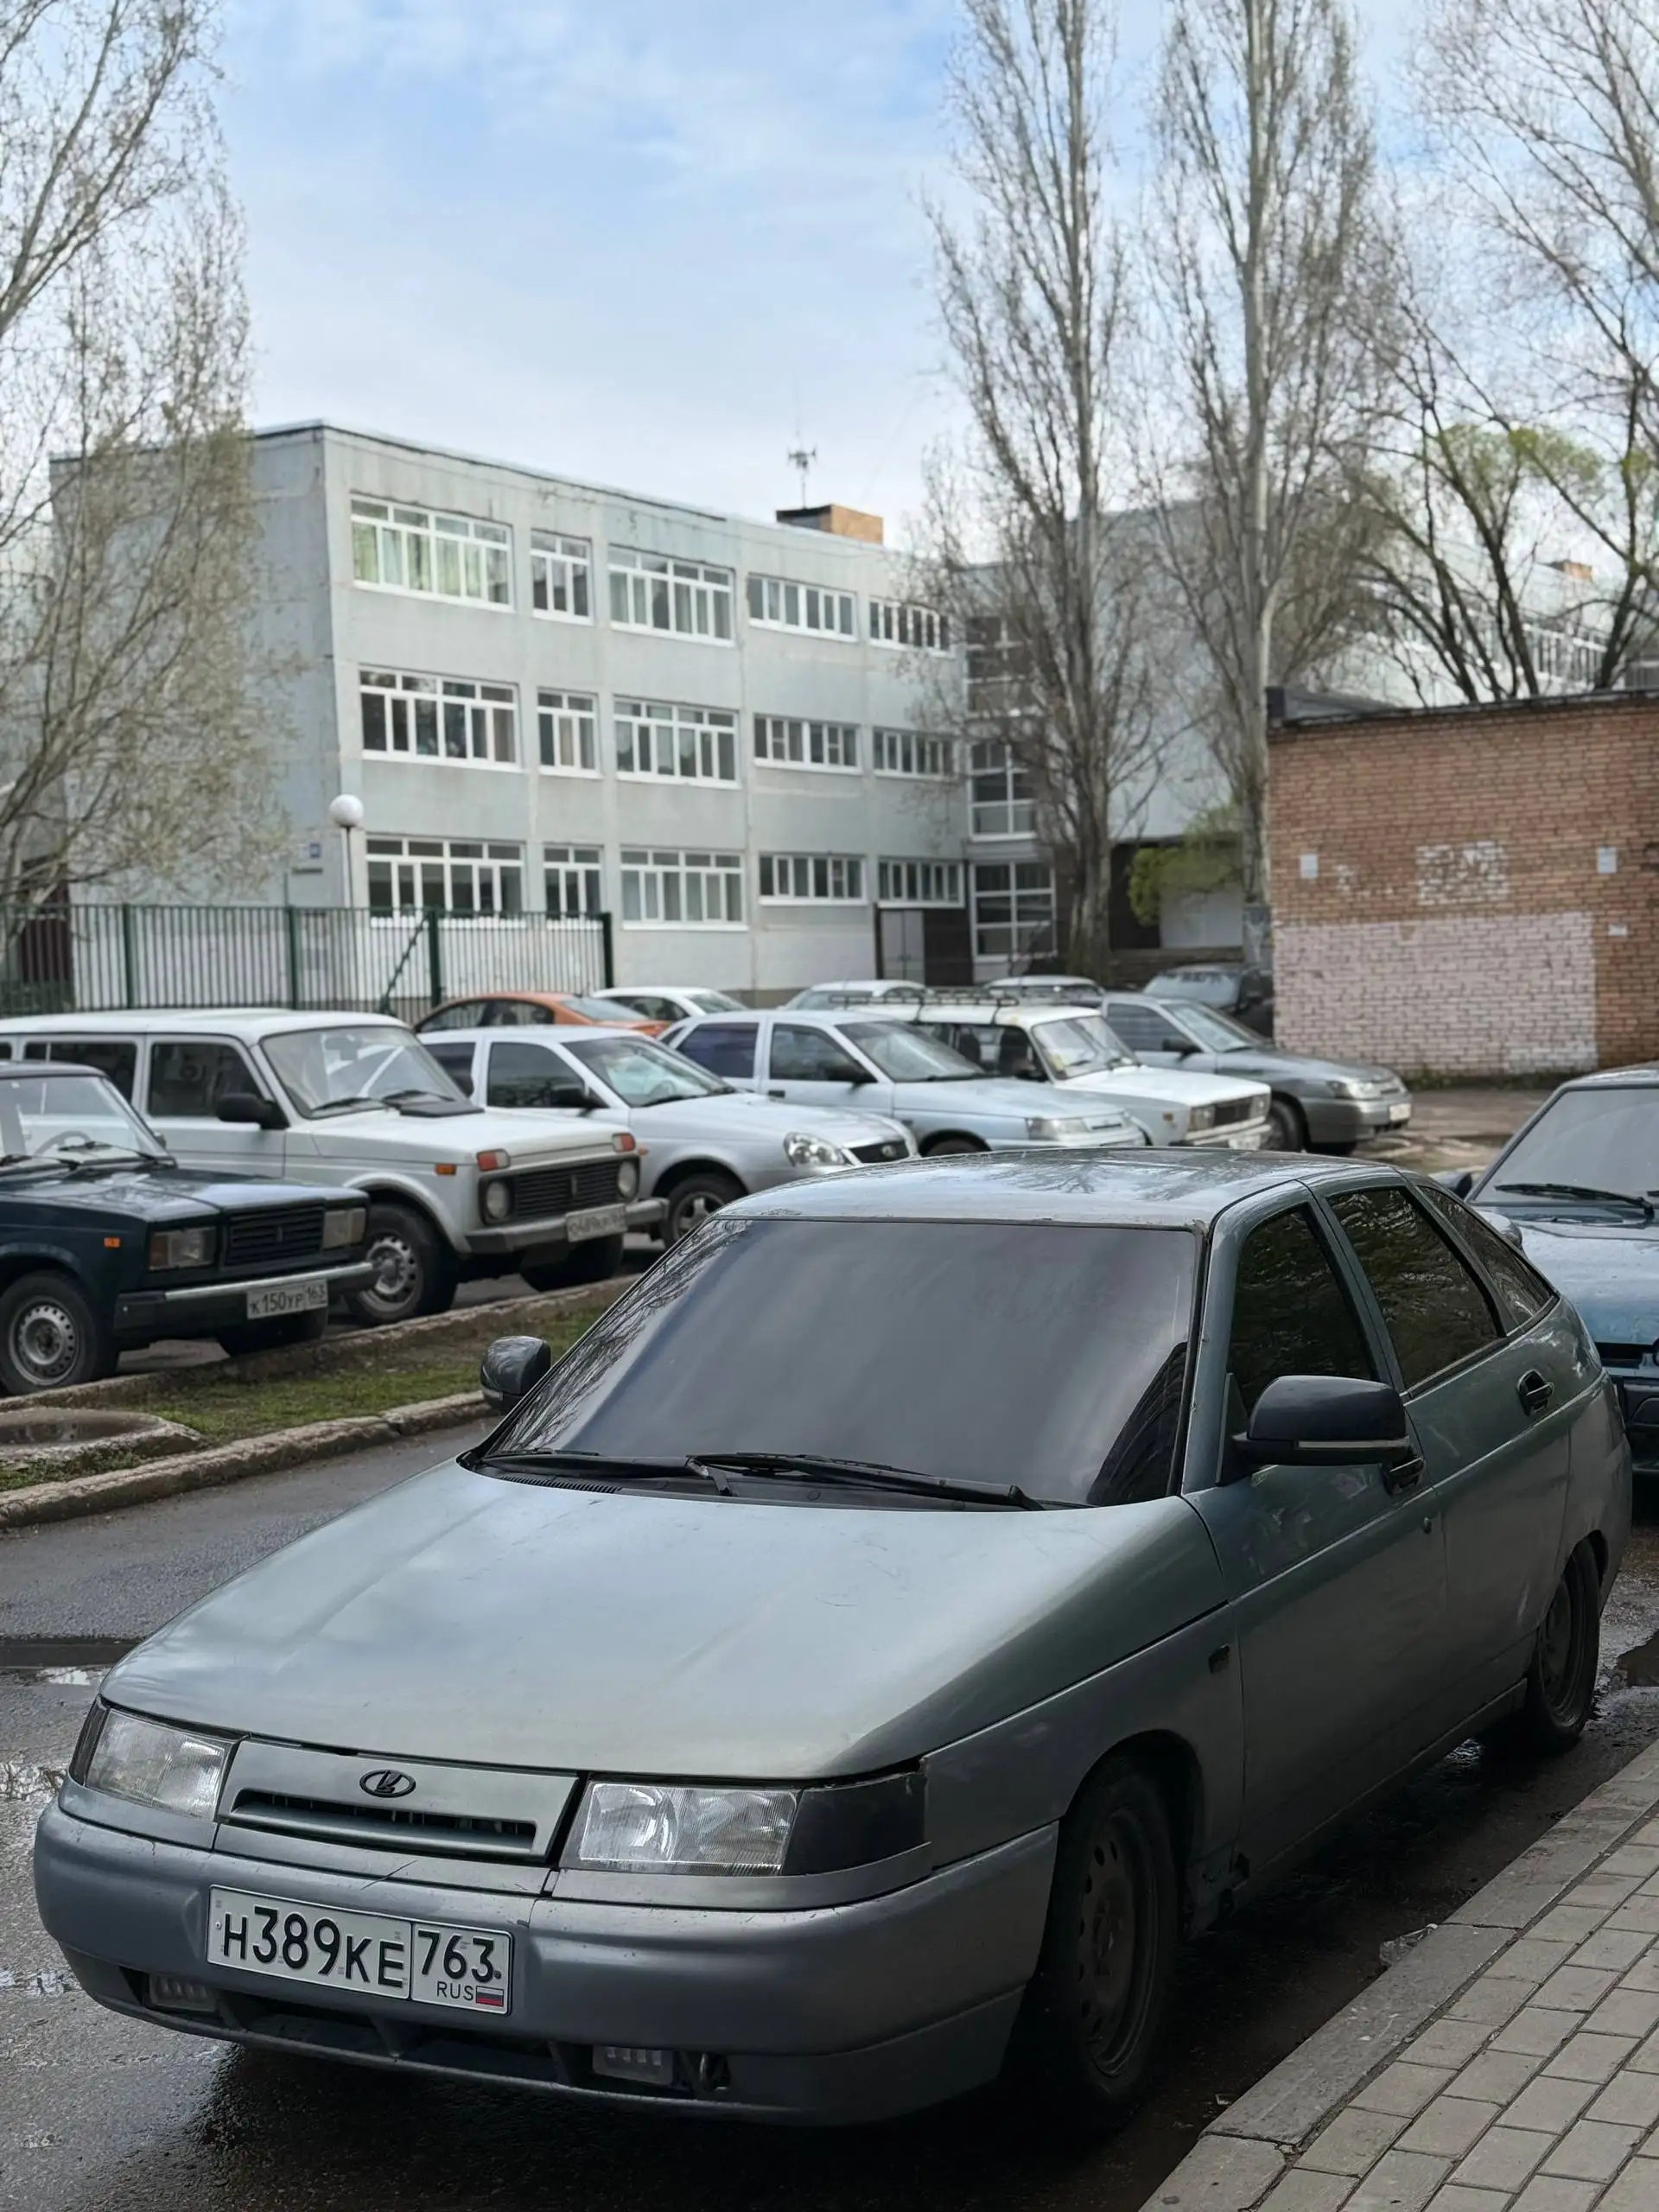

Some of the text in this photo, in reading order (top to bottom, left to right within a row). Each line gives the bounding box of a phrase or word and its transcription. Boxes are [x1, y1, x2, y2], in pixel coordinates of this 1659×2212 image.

[222, 1904, 495, 1988] Н389КЕ 763
[435, 1980, 474, 2002] RUS
